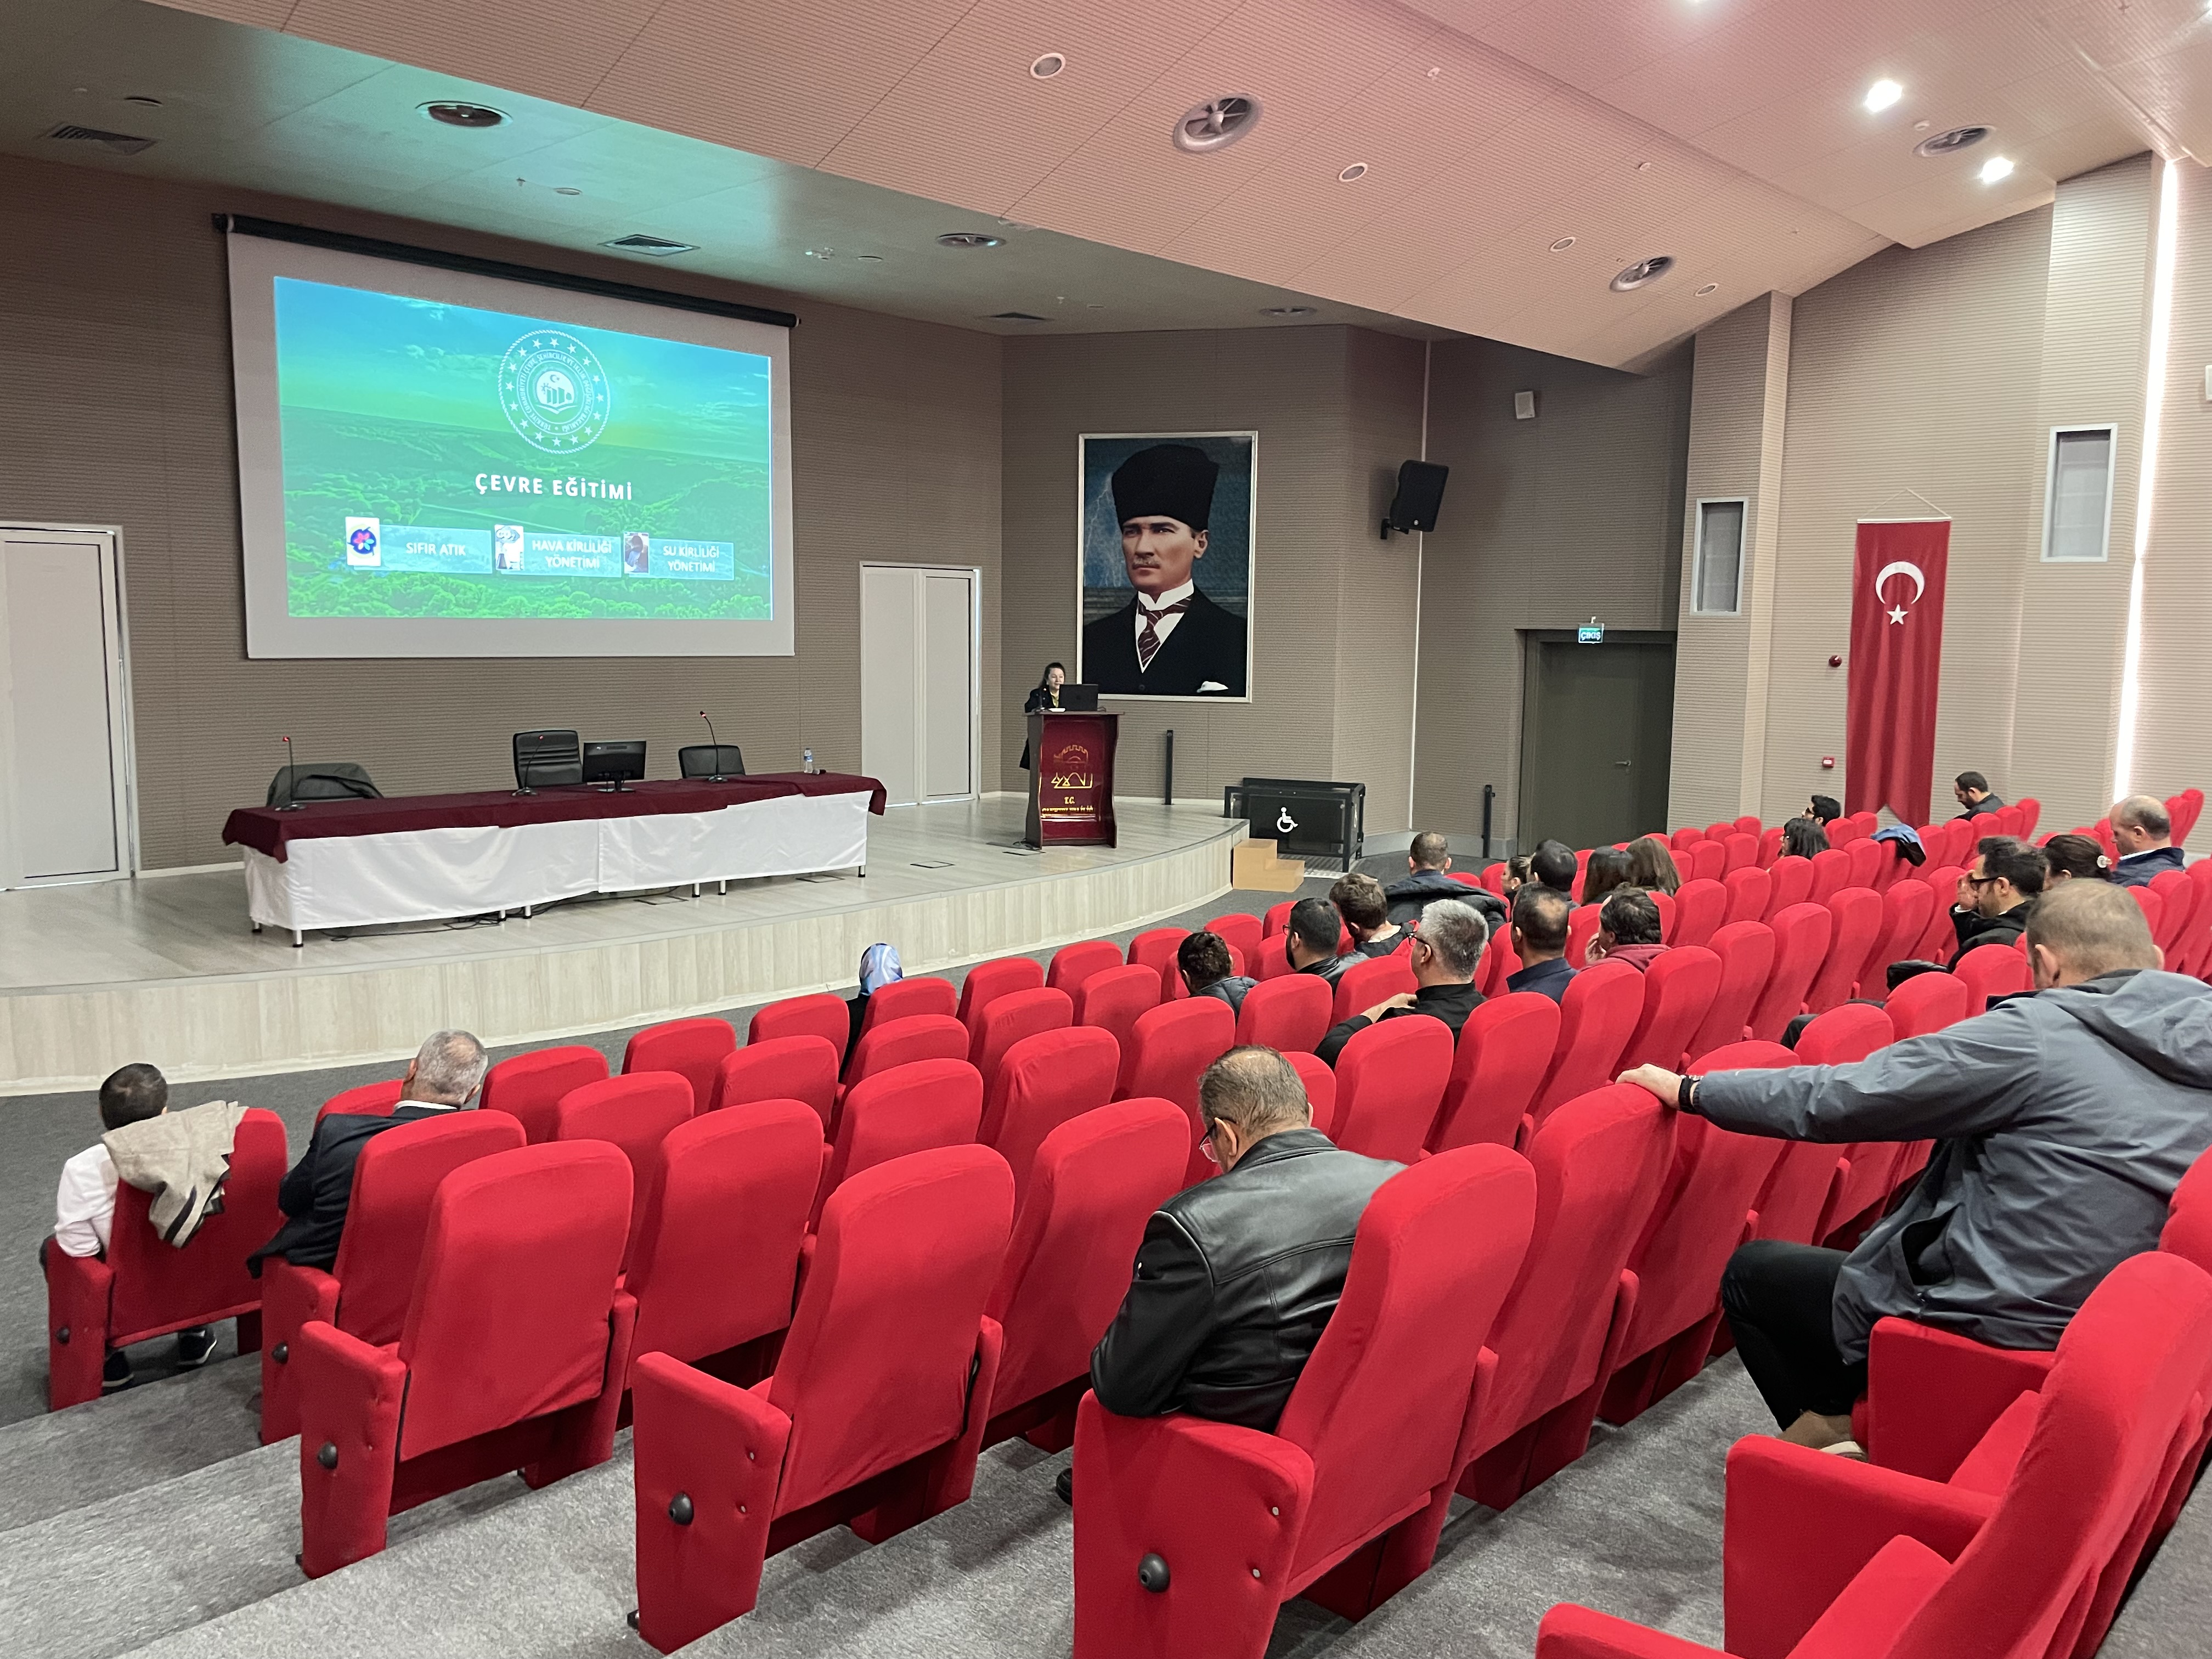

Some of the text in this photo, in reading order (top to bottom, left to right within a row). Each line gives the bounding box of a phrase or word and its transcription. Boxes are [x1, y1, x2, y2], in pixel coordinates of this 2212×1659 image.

[475, 473, 632, 500] ÇEVRE EĞİTİMİ
[406, 542, 466, 556] SIFIR ATIK
[532, 539, 612, 554] HAVA KİRLİLİĞİ
[663, 544, 719, 558] SU KİRLİLİĞİ
[545, 554, 600, 568] YÖNETİMİ
[668, 559, 715, 572] YÖNETİMİ
[1581, 631, 1601, 641] ÇIKIŞ
